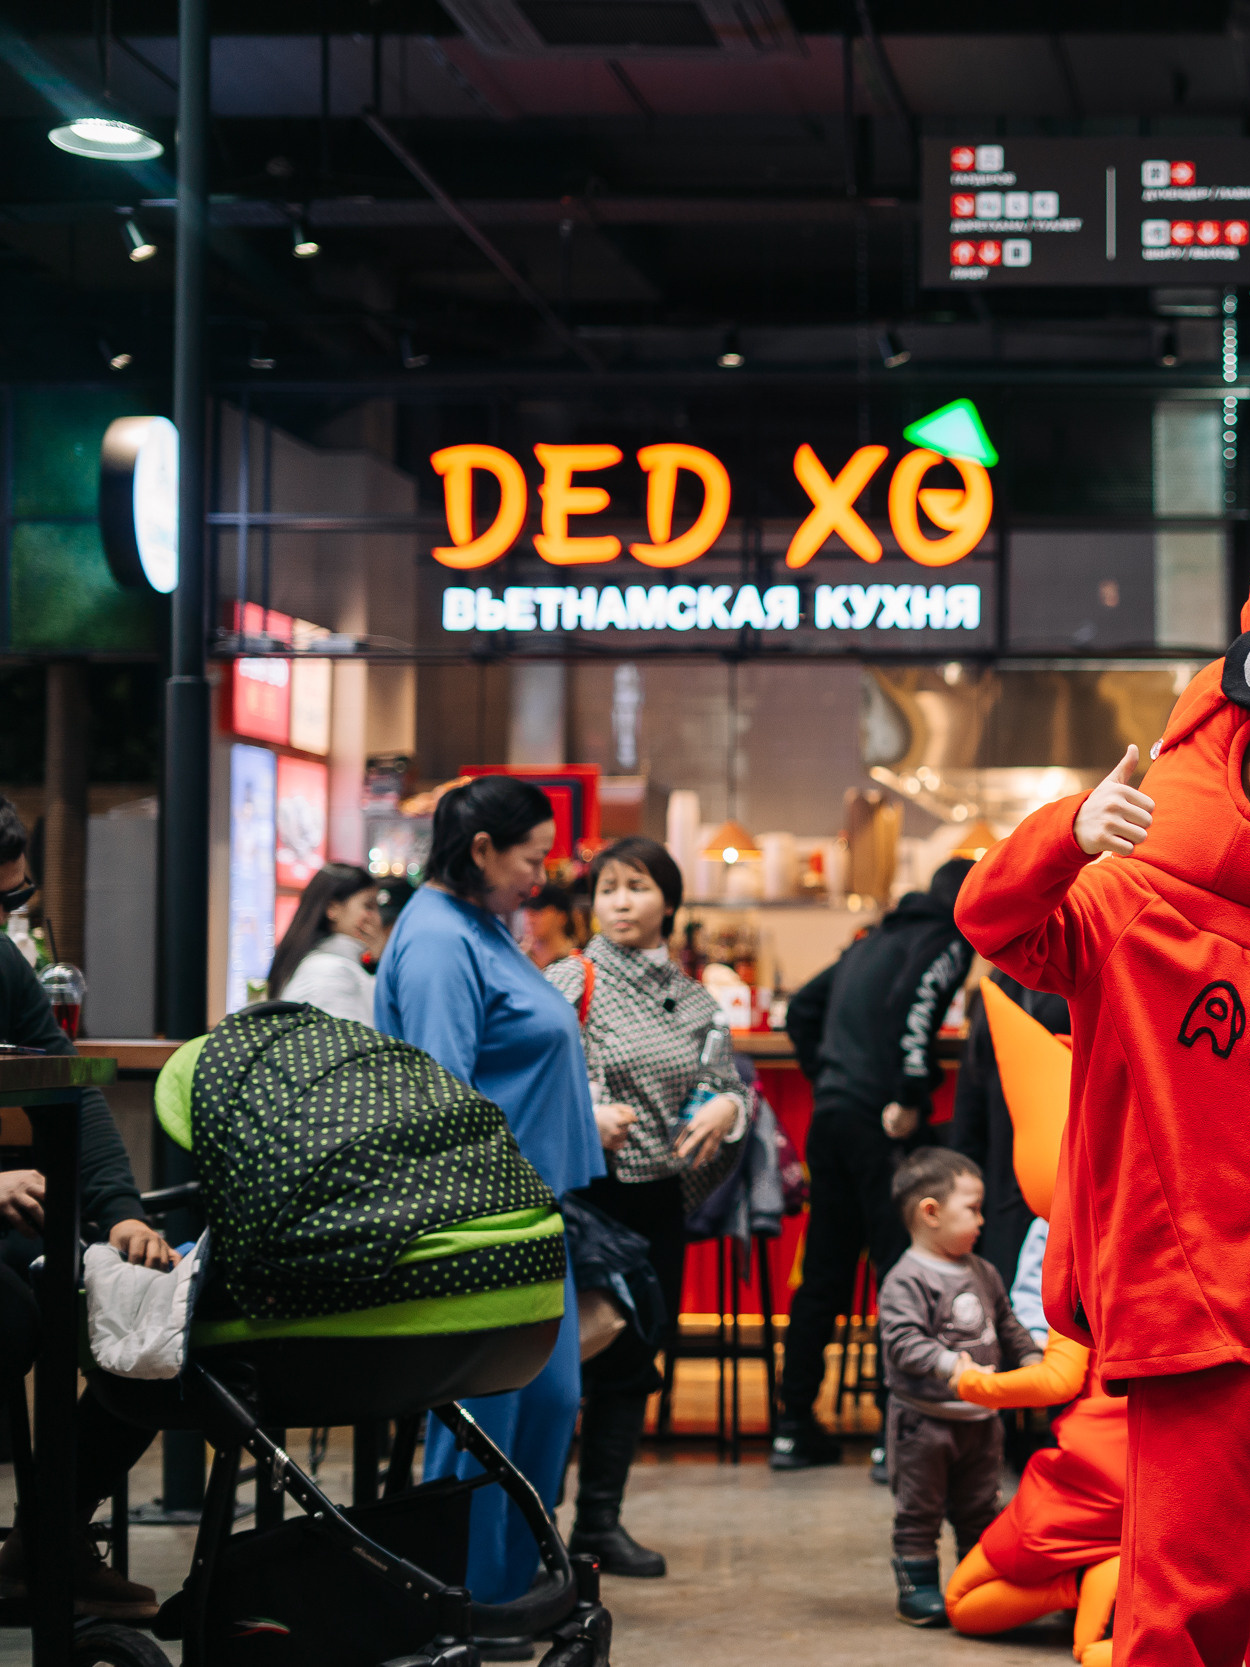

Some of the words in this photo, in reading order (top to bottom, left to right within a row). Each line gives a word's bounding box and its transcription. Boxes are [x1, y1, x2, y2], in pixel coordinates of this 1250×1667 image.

[430, 442, 732, 569] DED
[442, 585, 800, 632] ВЬЕТНАМСКАЯ
[813, 584, 981, 631] КУХНЯ
